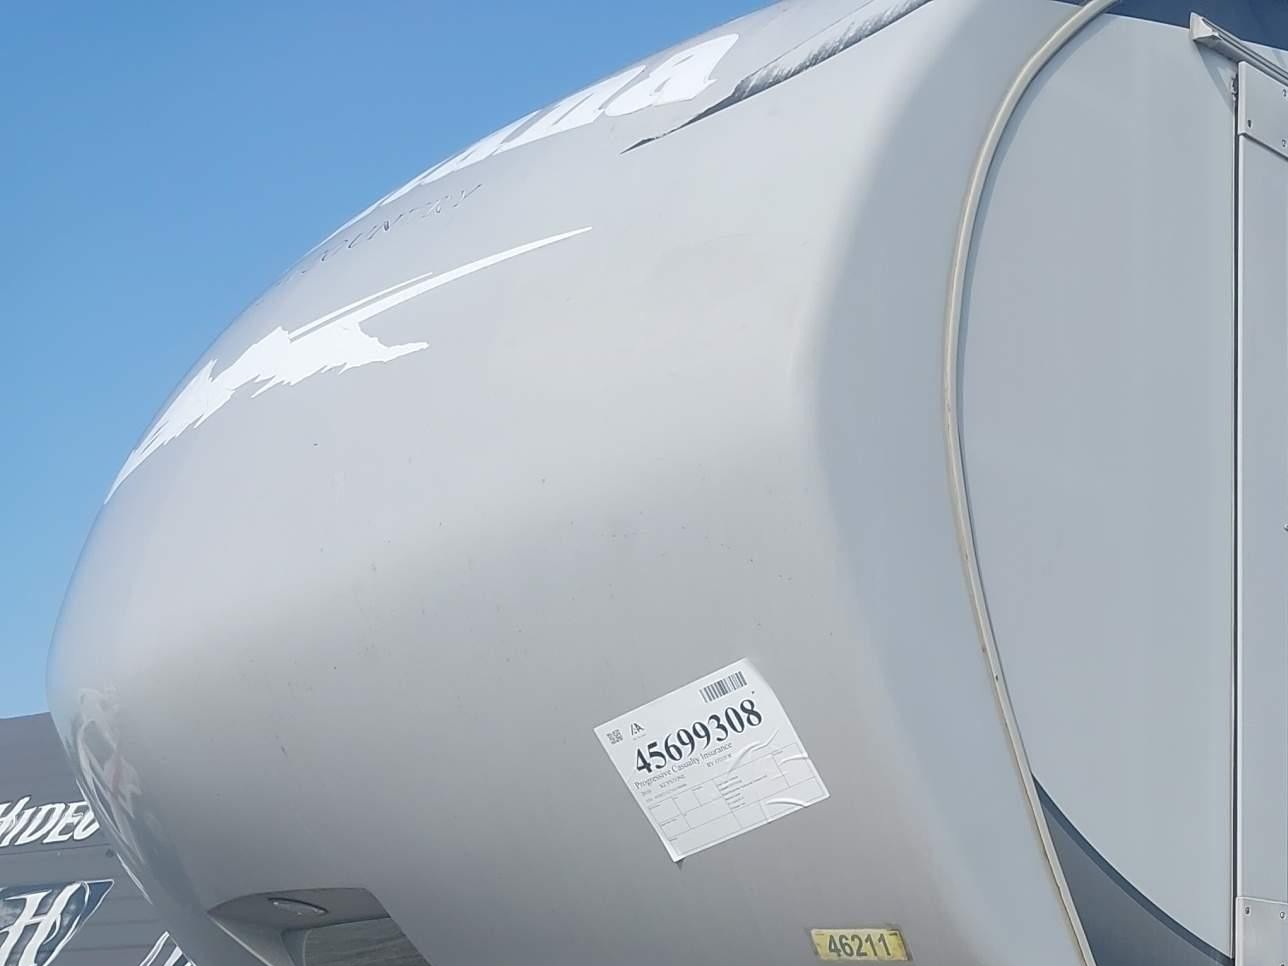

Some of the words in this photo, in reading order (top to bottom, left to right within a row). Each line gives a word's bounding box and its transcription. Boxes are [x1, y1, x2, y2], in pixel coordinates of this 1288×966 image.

[634, 698, 763, 774] 45699308
[633, 768, 672, 790] Progressive
[671, 755, 700, 772] Casualty
[700, 742, 732, 761] Insurance
[828, 933, 892, 957] 46211
